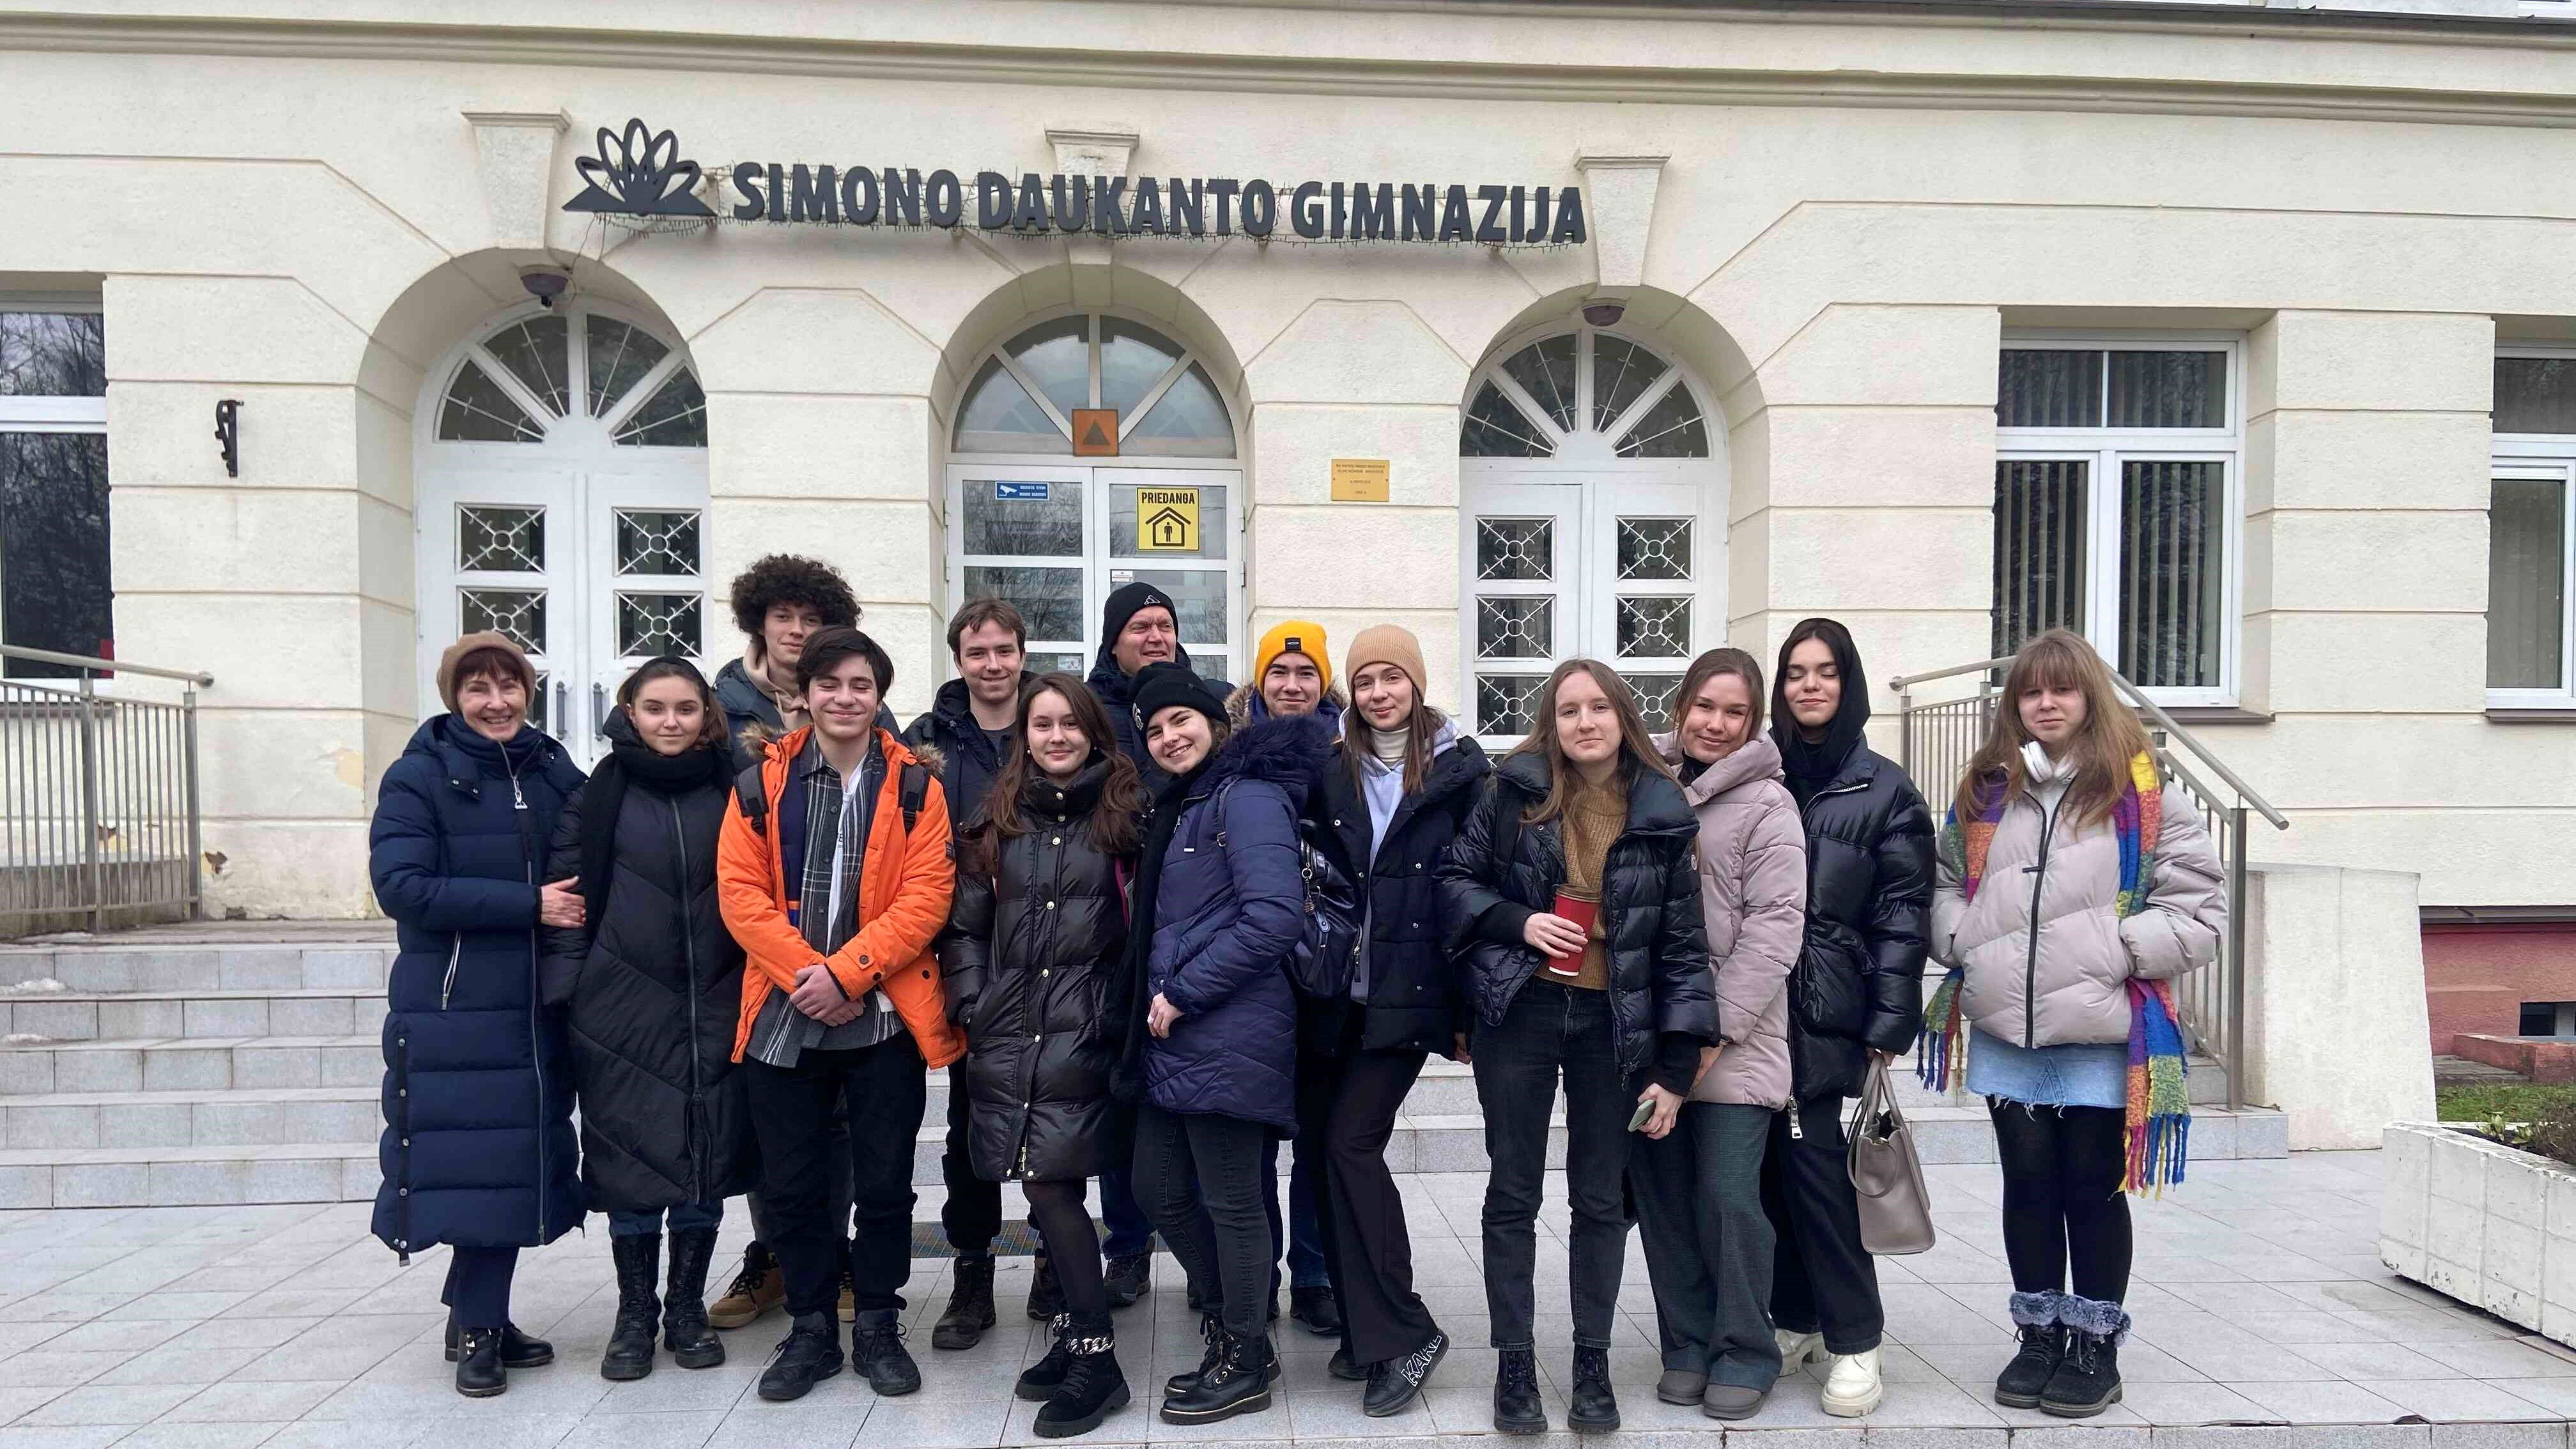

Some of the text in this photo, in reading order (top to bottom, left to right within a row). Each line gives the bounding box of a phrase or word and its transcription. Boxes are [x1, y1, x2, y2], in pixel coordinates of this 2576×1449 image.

[733, 162, 1587, 244] SIMONO DAUKANTO GIMNAZIJA
[1141, 492, 1195, 504] PRIEDANGA
